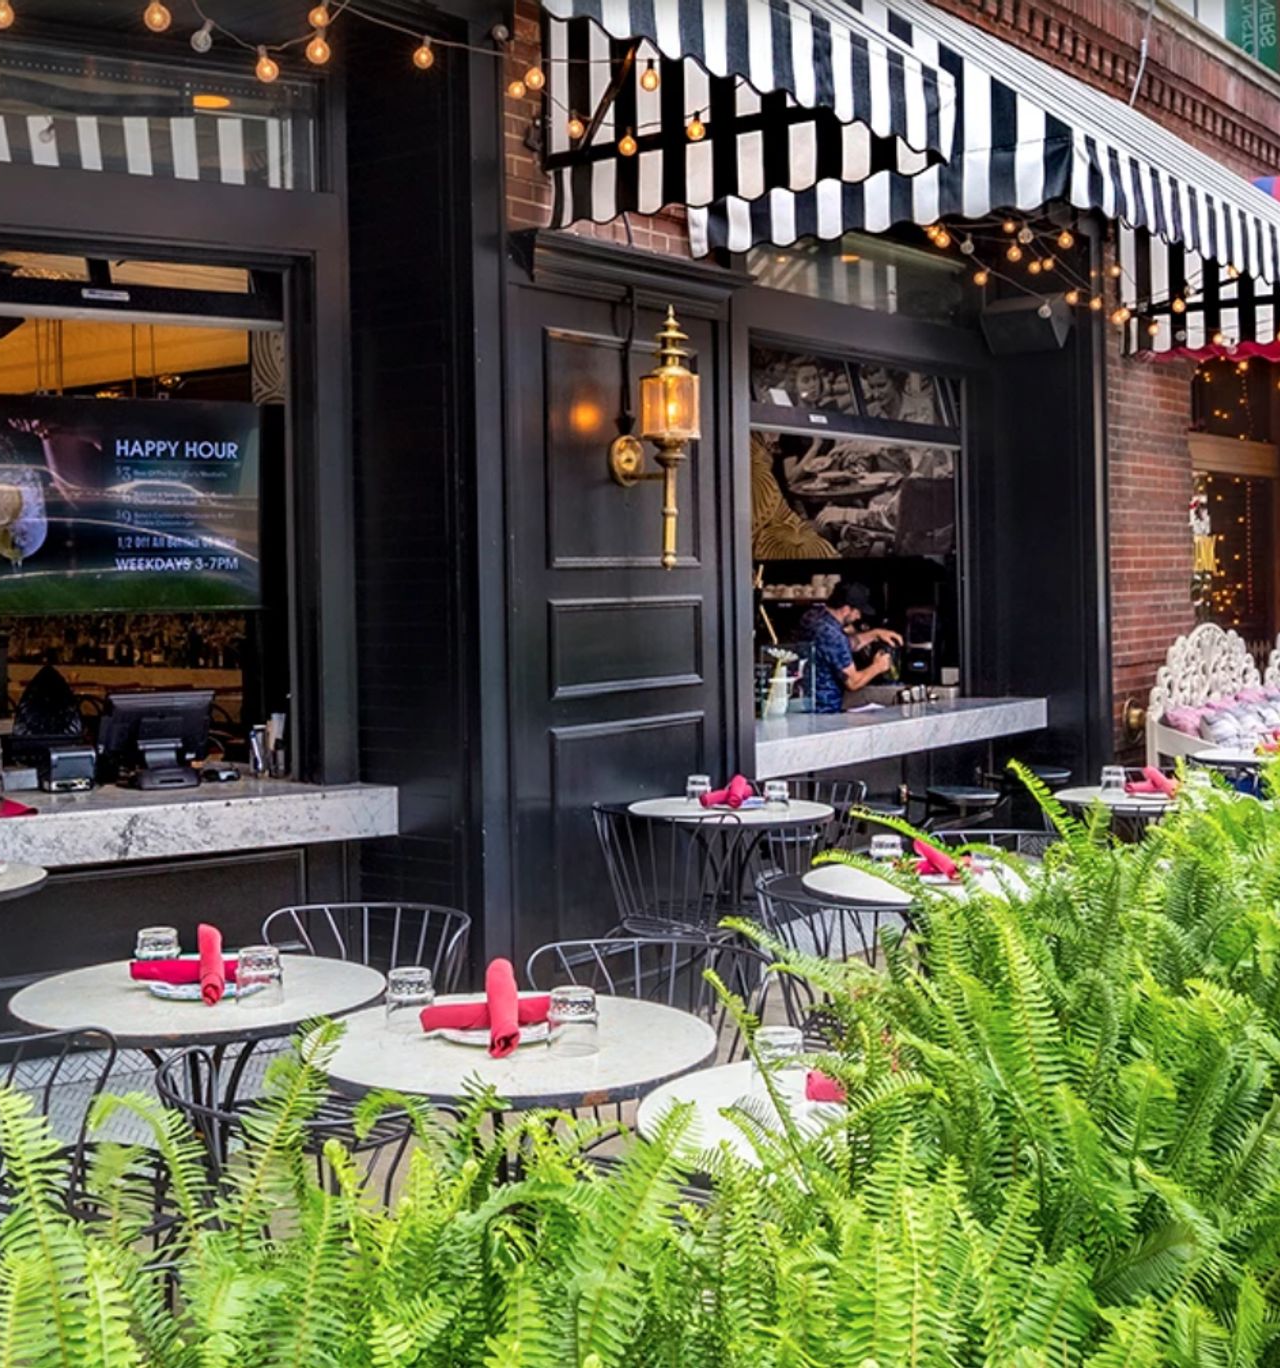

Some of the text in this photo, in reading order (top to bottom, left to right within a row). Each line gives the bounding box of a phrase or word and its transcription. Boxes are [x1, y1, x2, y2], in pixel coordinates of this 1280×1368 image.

[116, 440, 238, 459] HAPPY HOUR
[115, 557, 239, 571] WEEKDAYS 3-7PM
